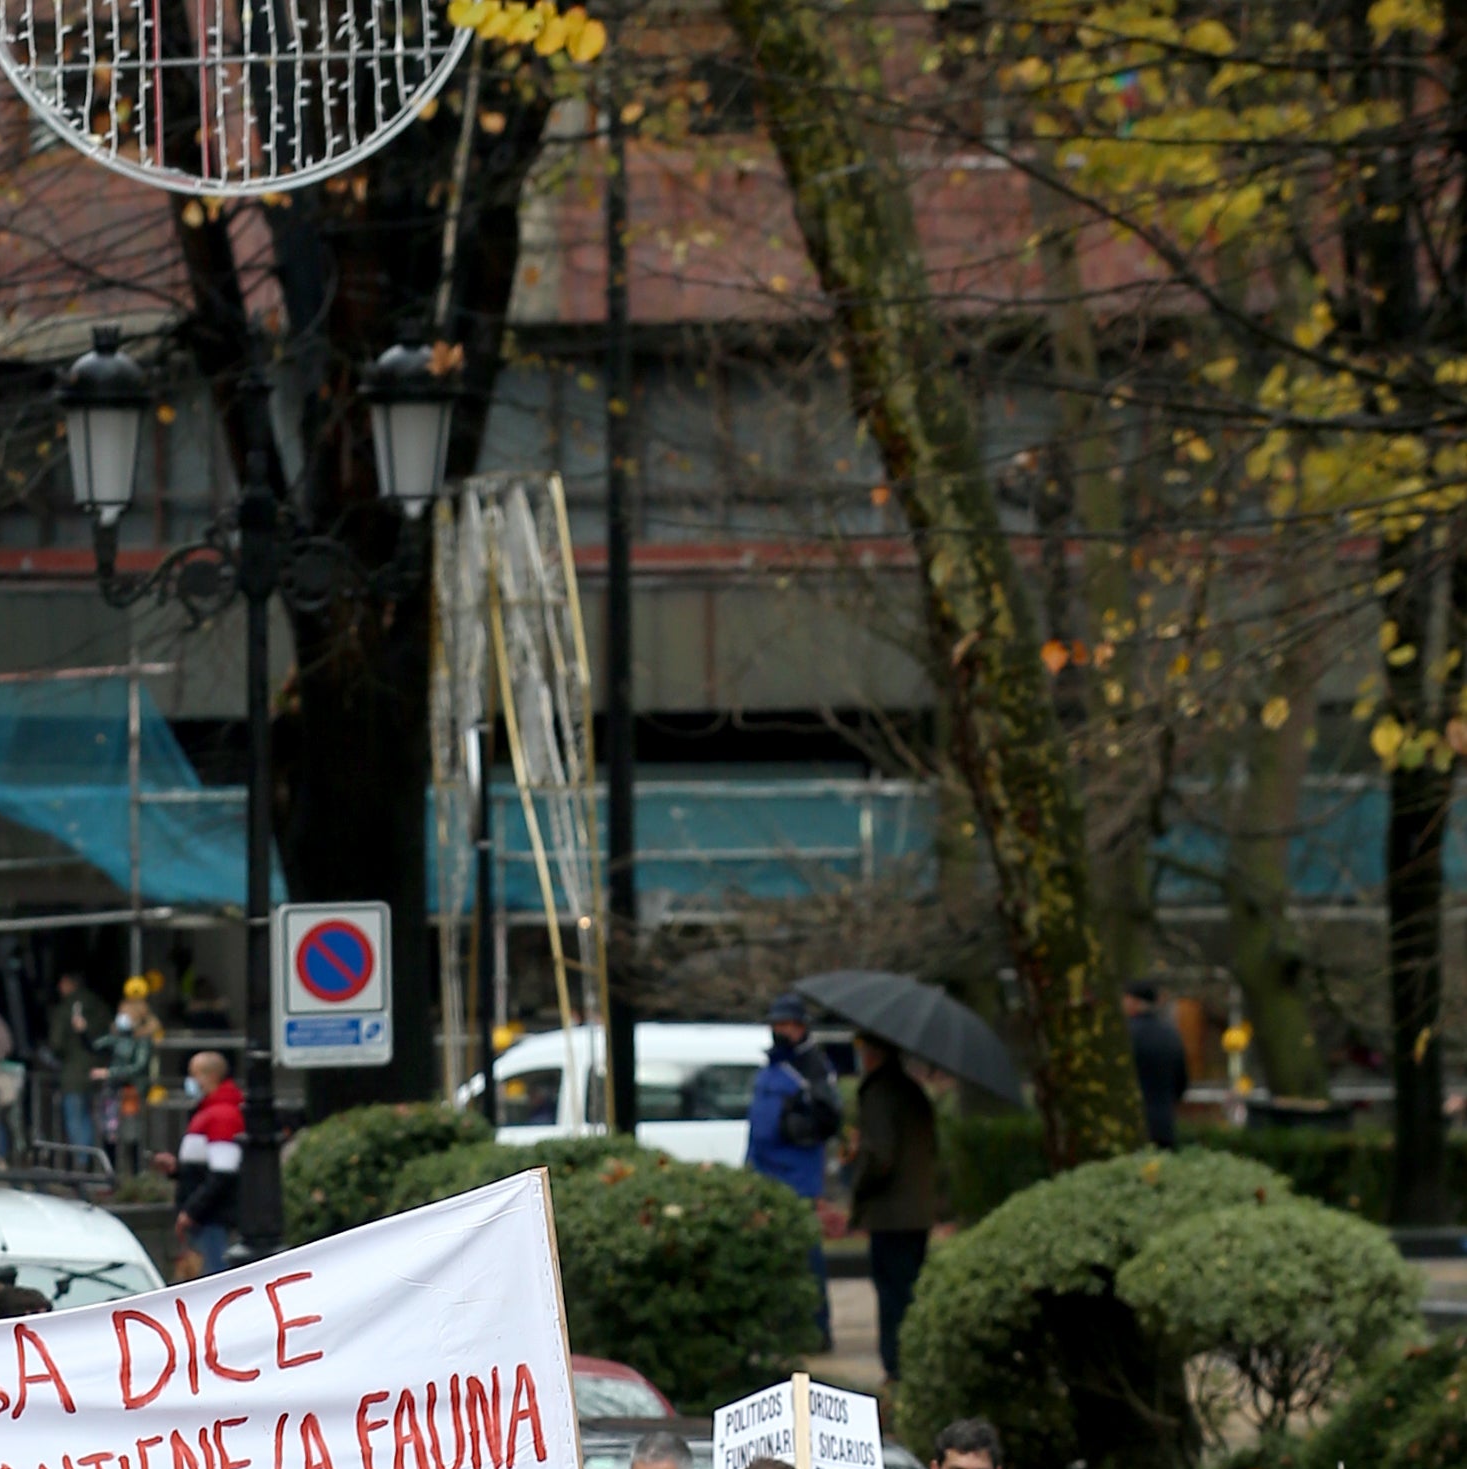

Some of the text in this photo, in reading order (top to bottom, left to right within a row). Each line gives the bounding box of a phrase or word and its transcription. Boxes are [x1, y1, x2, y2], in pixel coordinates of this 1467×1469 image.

[113, 1271, 323, 1411] DICE
[725, 1392, 783, 1437] POLITICOS
[819, 1432, 876, 1467] SICARIOS
